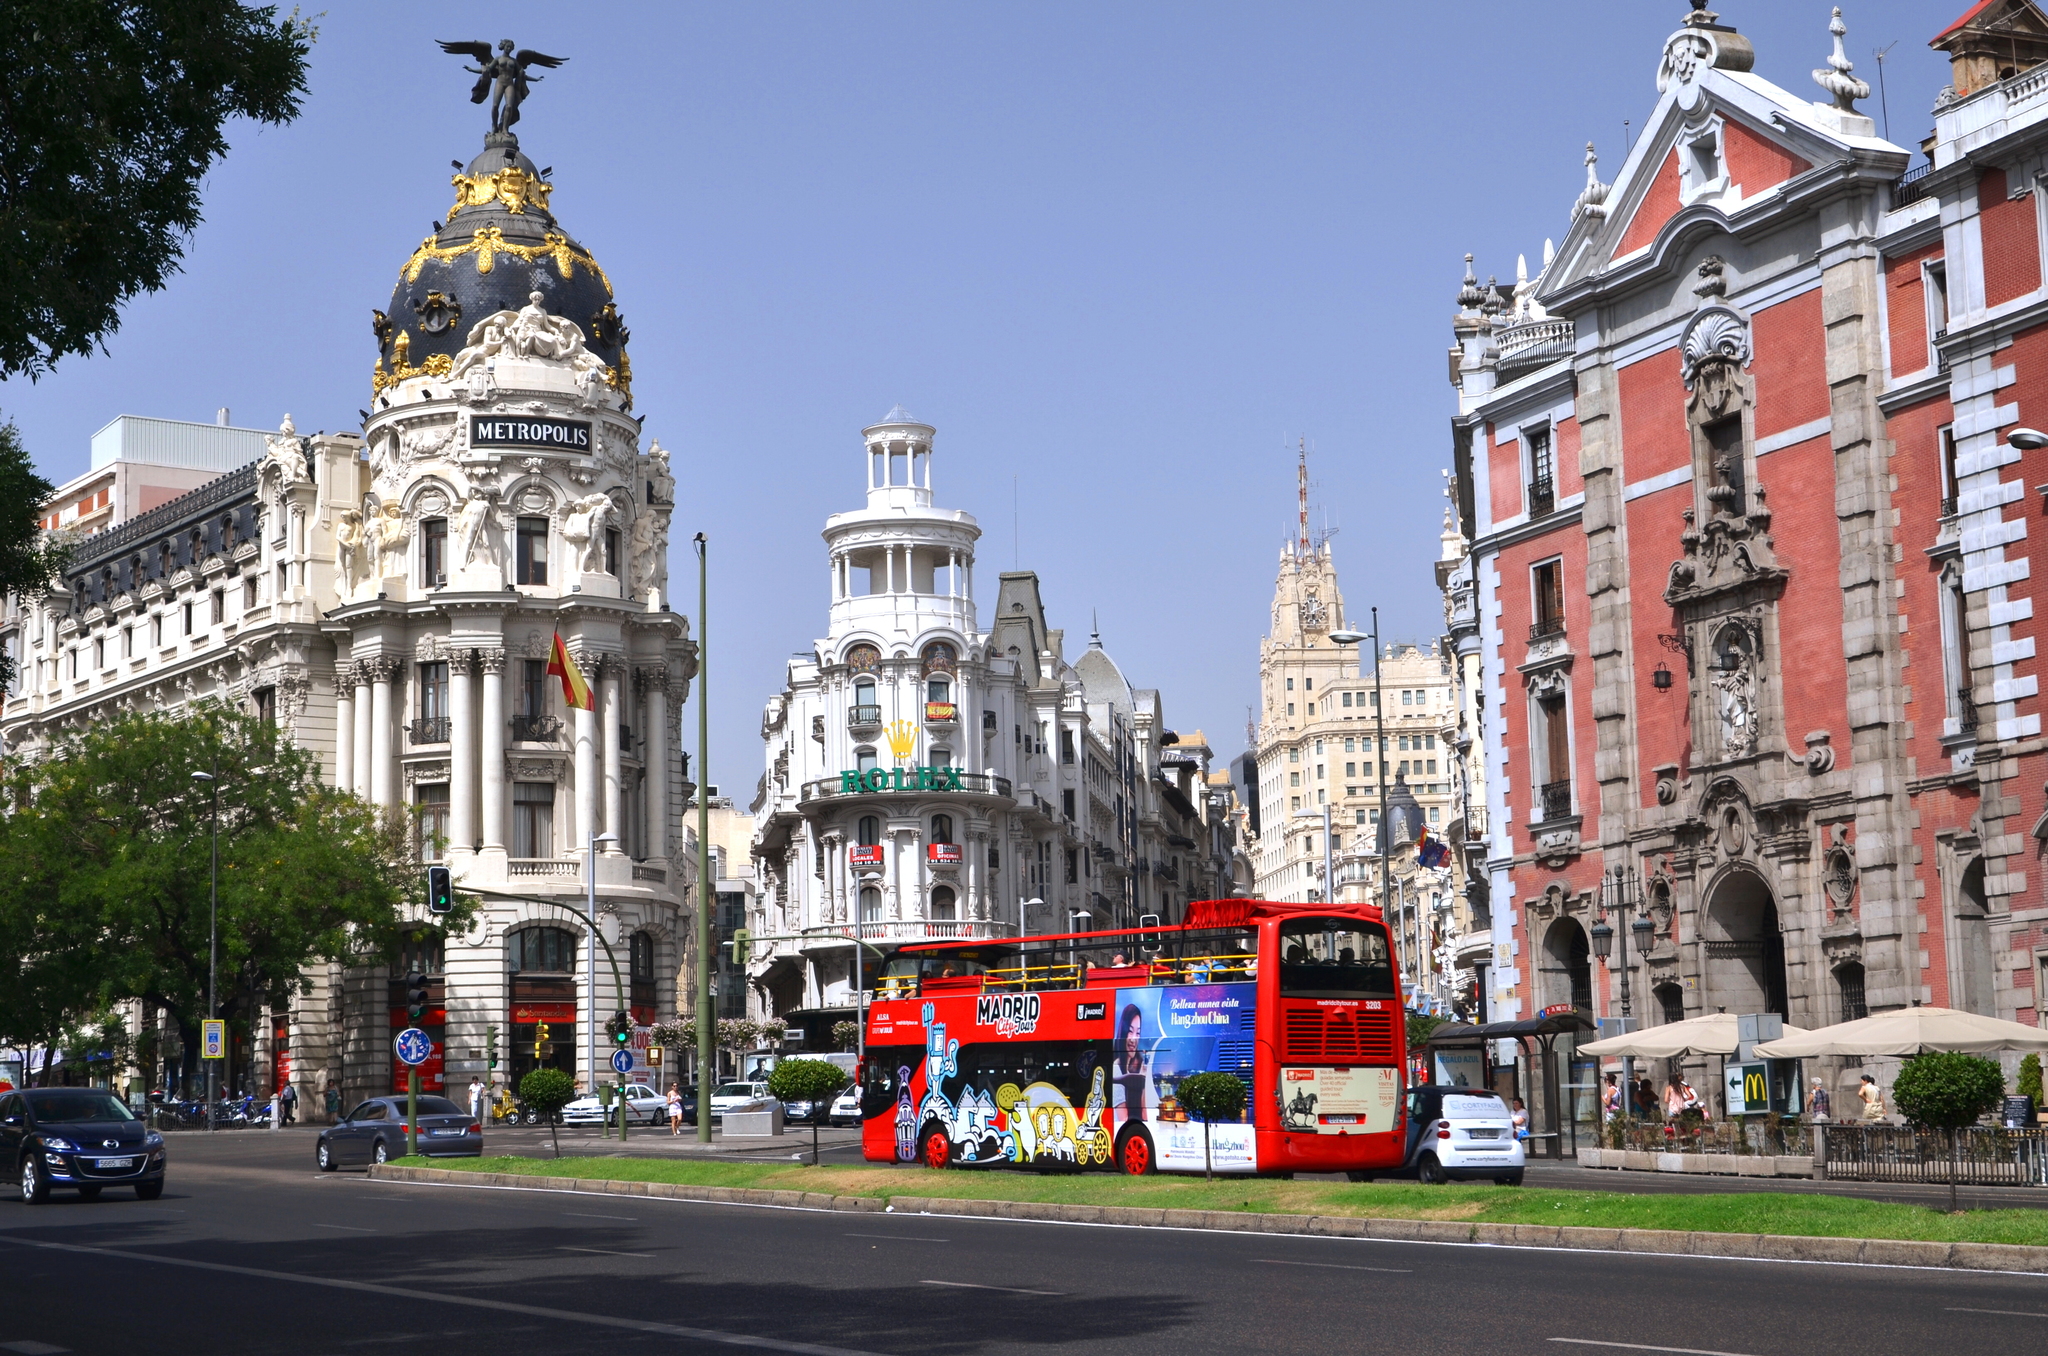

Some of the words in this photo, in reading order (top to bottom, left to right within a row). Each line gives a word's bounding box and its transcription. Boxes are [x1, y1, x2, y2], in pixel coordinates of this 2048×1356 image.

[478, 422, 588, 446] METROPOLIS
[840, 766, 967, 793] ROLEX
[977, 994, 1040, 1025] MADRID
[1170, 998, 1197, 1010] Belleza
[1197, 1000, 1220, 1009] nunca
[1221, 997, 1240, 1008] vista
[1365, 1001, 1382, 1010] 3203
[530, 1009, 567, 1017] Santander
[876, 1013, 890, 1021] ALSA
[1171, 1012, 1208, 1029] Hangzhou
[1208, 1011, 1230, 1025] China
[996, 1017, 1014, 1037] City
[1014, 1014, 1036, 1033] Tour
[1212, 1138, 1245, 1153] Hangzhou
